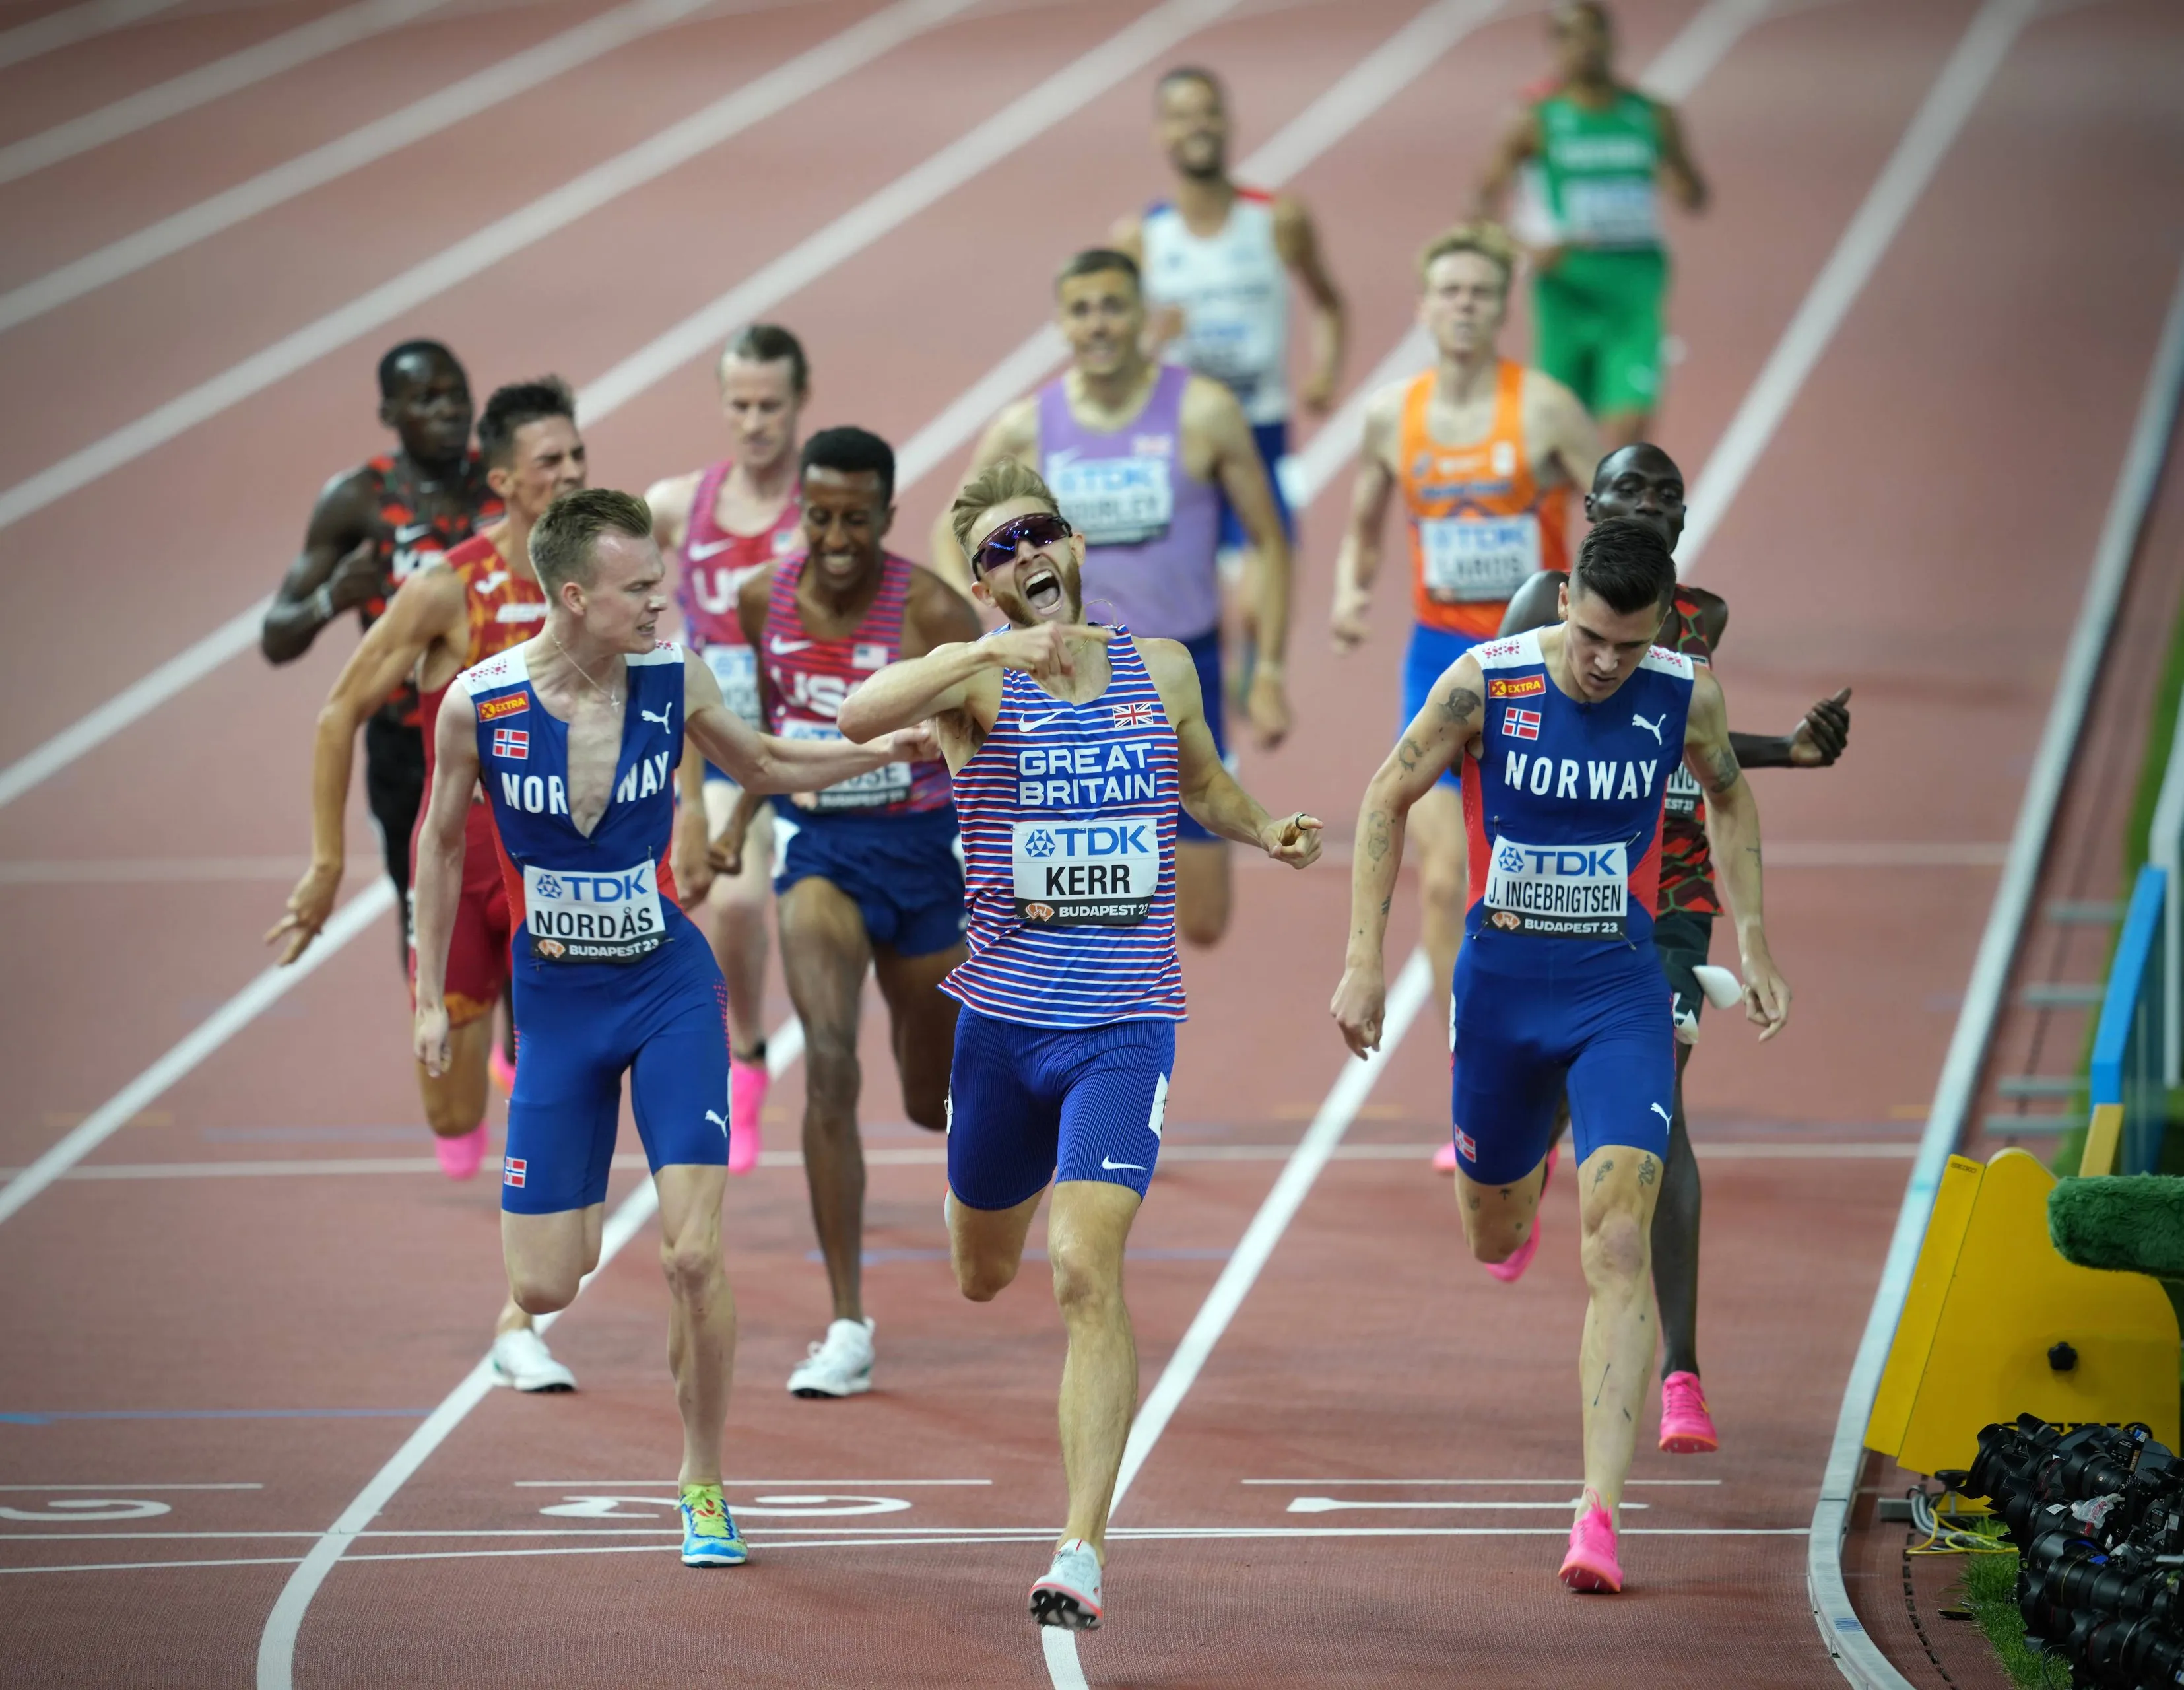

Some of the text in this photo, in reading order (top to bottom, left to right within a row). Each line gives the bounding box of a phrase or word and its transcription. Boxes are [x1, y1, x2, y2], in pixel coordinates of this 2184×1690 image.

[770, 666, 863, 717] US
[1508, 680, 1541, 693] EXTRA
[496, 697, 526, 712] EXTRA
[1019, 743, 1152, 776] GREAT
[1020, 774, 1155, 805] BRITAIN
[1504, 751, 1657, 800] NORWAY
[1055, 825, 1150, 856] TDK
[1525, 848, 1617, 877] TDK
[561, 868, 649, 902] TDK
[1046, 865, 1131, 896] KERR
[1489, 877, 1621, 913] J. INGEBRIGTSEN
[535, 906, 653, 939] NORDÅS
[1059, 905, 1137, 918] BUDAPEST
[1525, 918, 1618, 933] BUDAPEST 23
[569, 939, 659, 957] BUDAPEST 23
